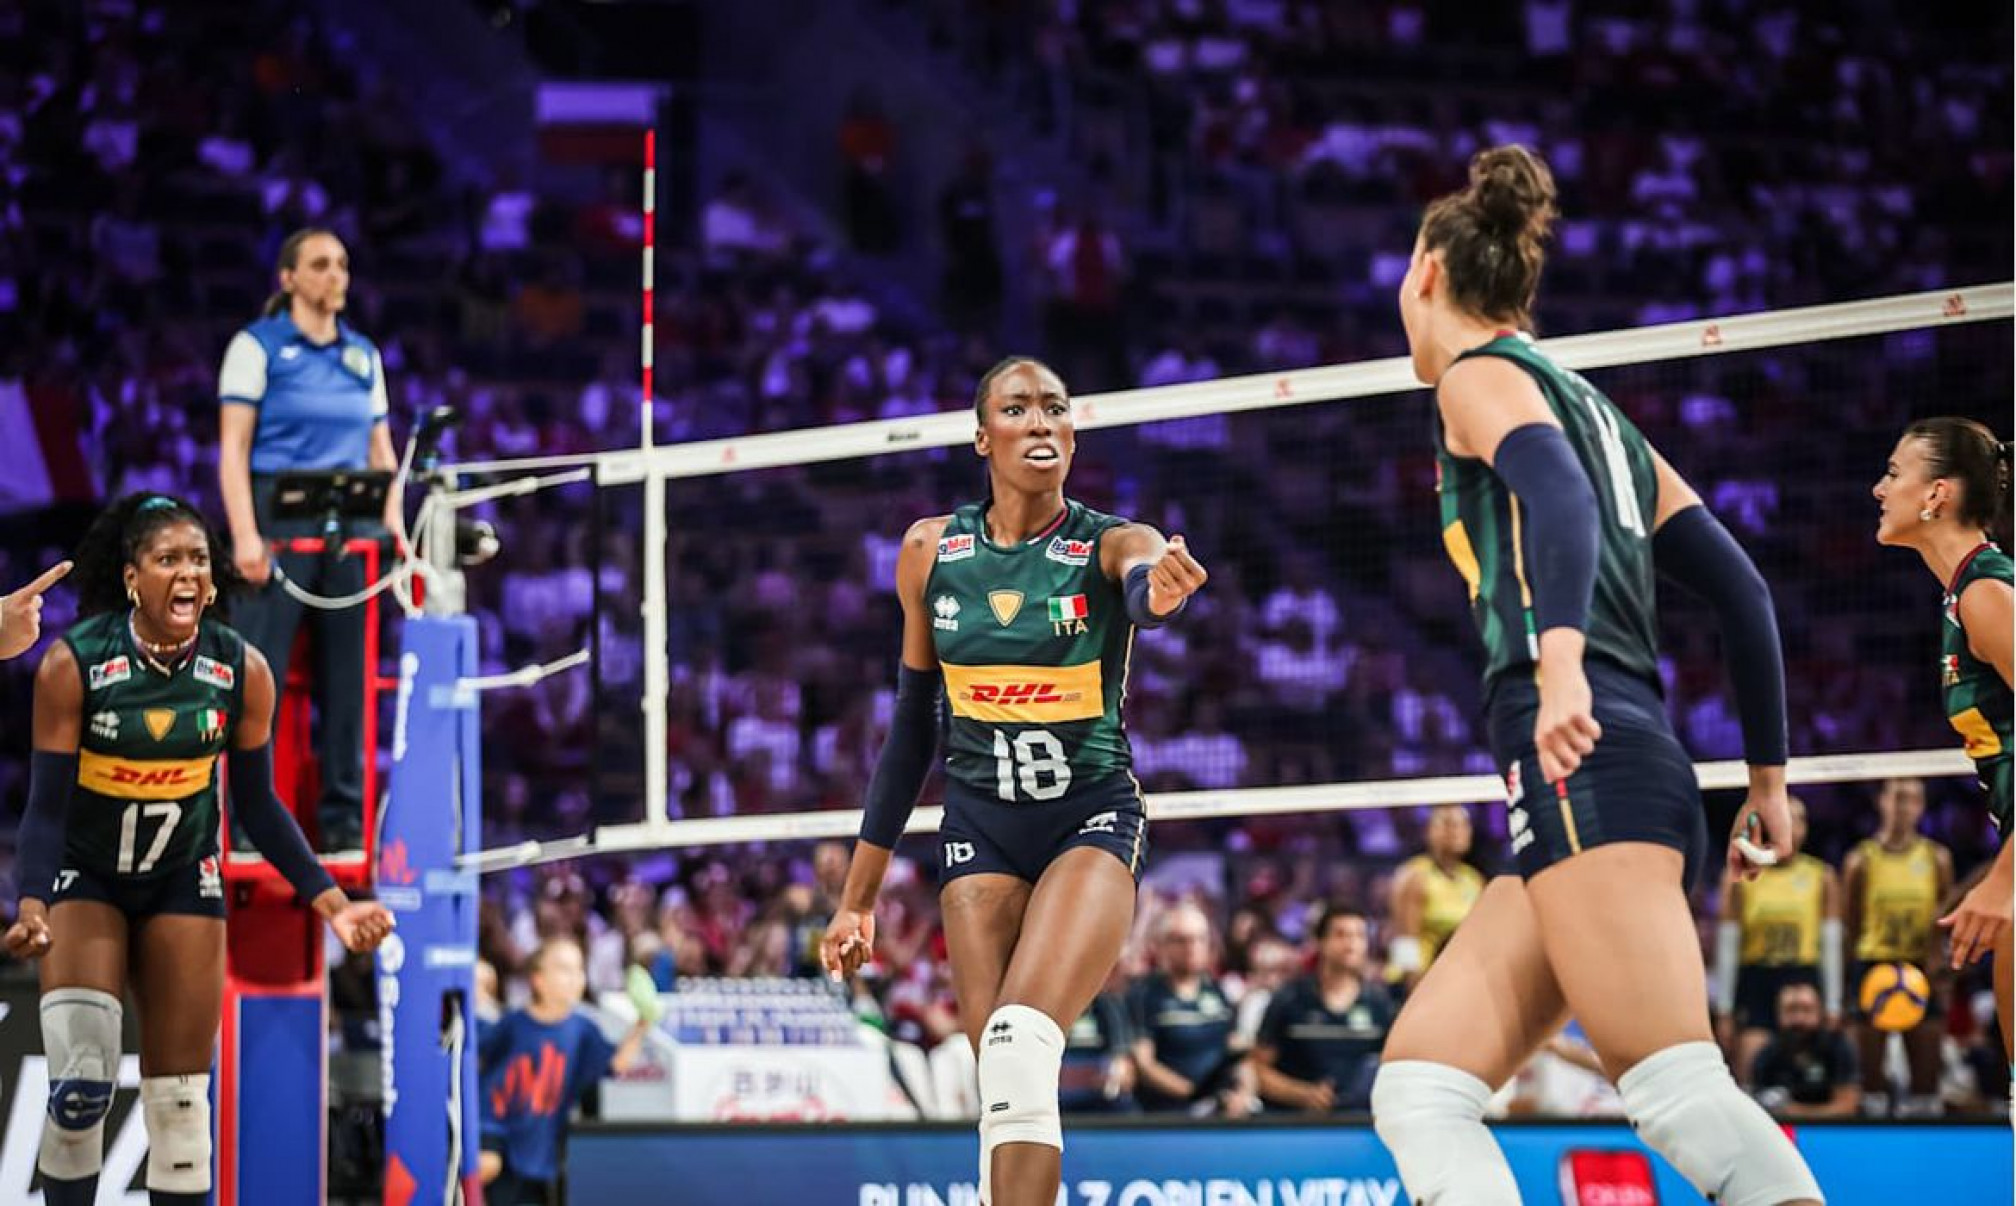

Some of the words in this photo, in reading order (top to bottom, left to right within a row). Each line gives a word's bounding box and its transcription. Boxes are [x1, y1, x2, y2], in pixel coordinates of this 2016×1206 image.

[1053, 618, 1090, 637] ITA
[969, 683, 1062, 705] DHL
[993, 729, 1073, 802] 18
[117, 802, 182, 873] 17
